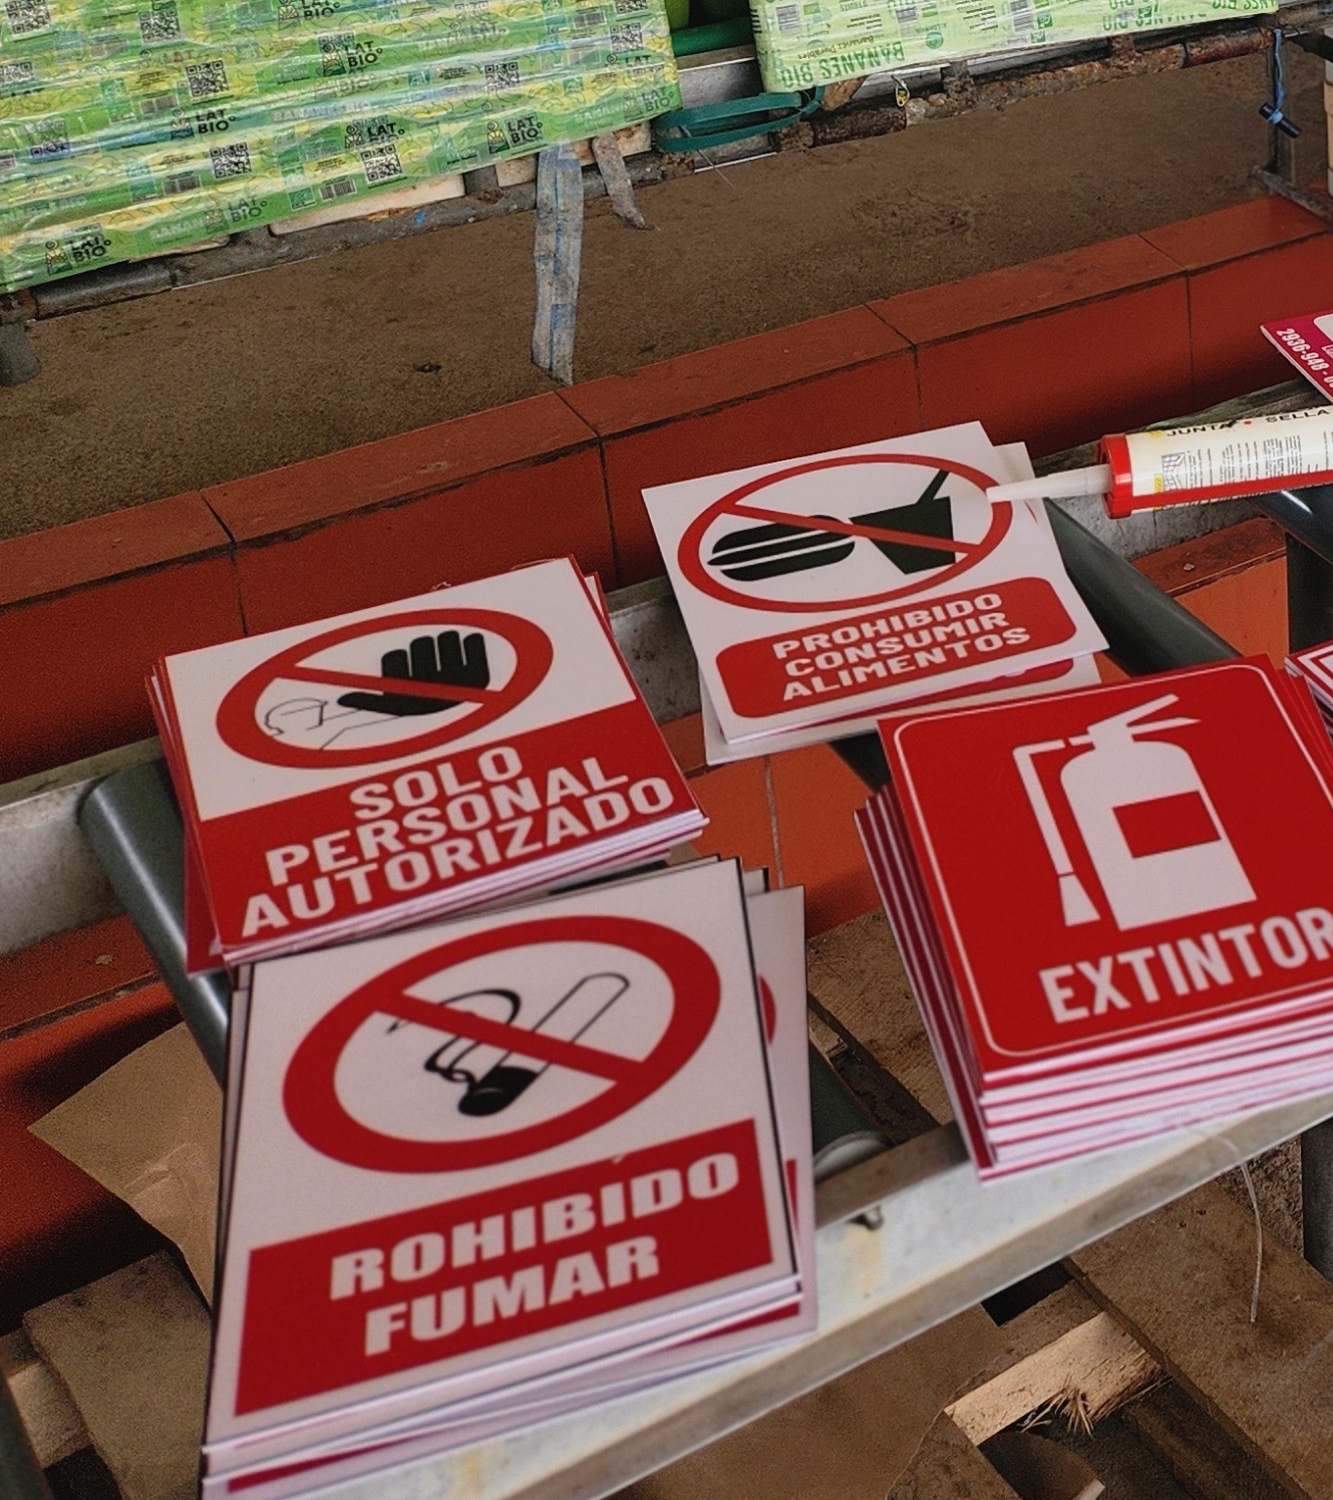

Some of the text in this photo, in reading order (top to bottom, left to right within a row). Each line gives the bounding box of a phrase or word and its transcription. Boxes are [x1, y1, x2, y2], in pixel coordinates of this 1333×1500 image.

[1166, 423, 1233, 437] JUNTA
[1266, 407, 1331, 423] SELLA
[772, 592, 1003, 660] PROHIBIDO
[785, 611, 1010, 677] CONSUMIR
[783, 626, 1031, 701] ALIMENTOS
[350, 746, 523, 820] SOLO
[241, 776, 674, 938] AUTORIZADO
[265, 756, 629, 887] PERSONAL
[365, 1235, 660, 1357] FUMAR
